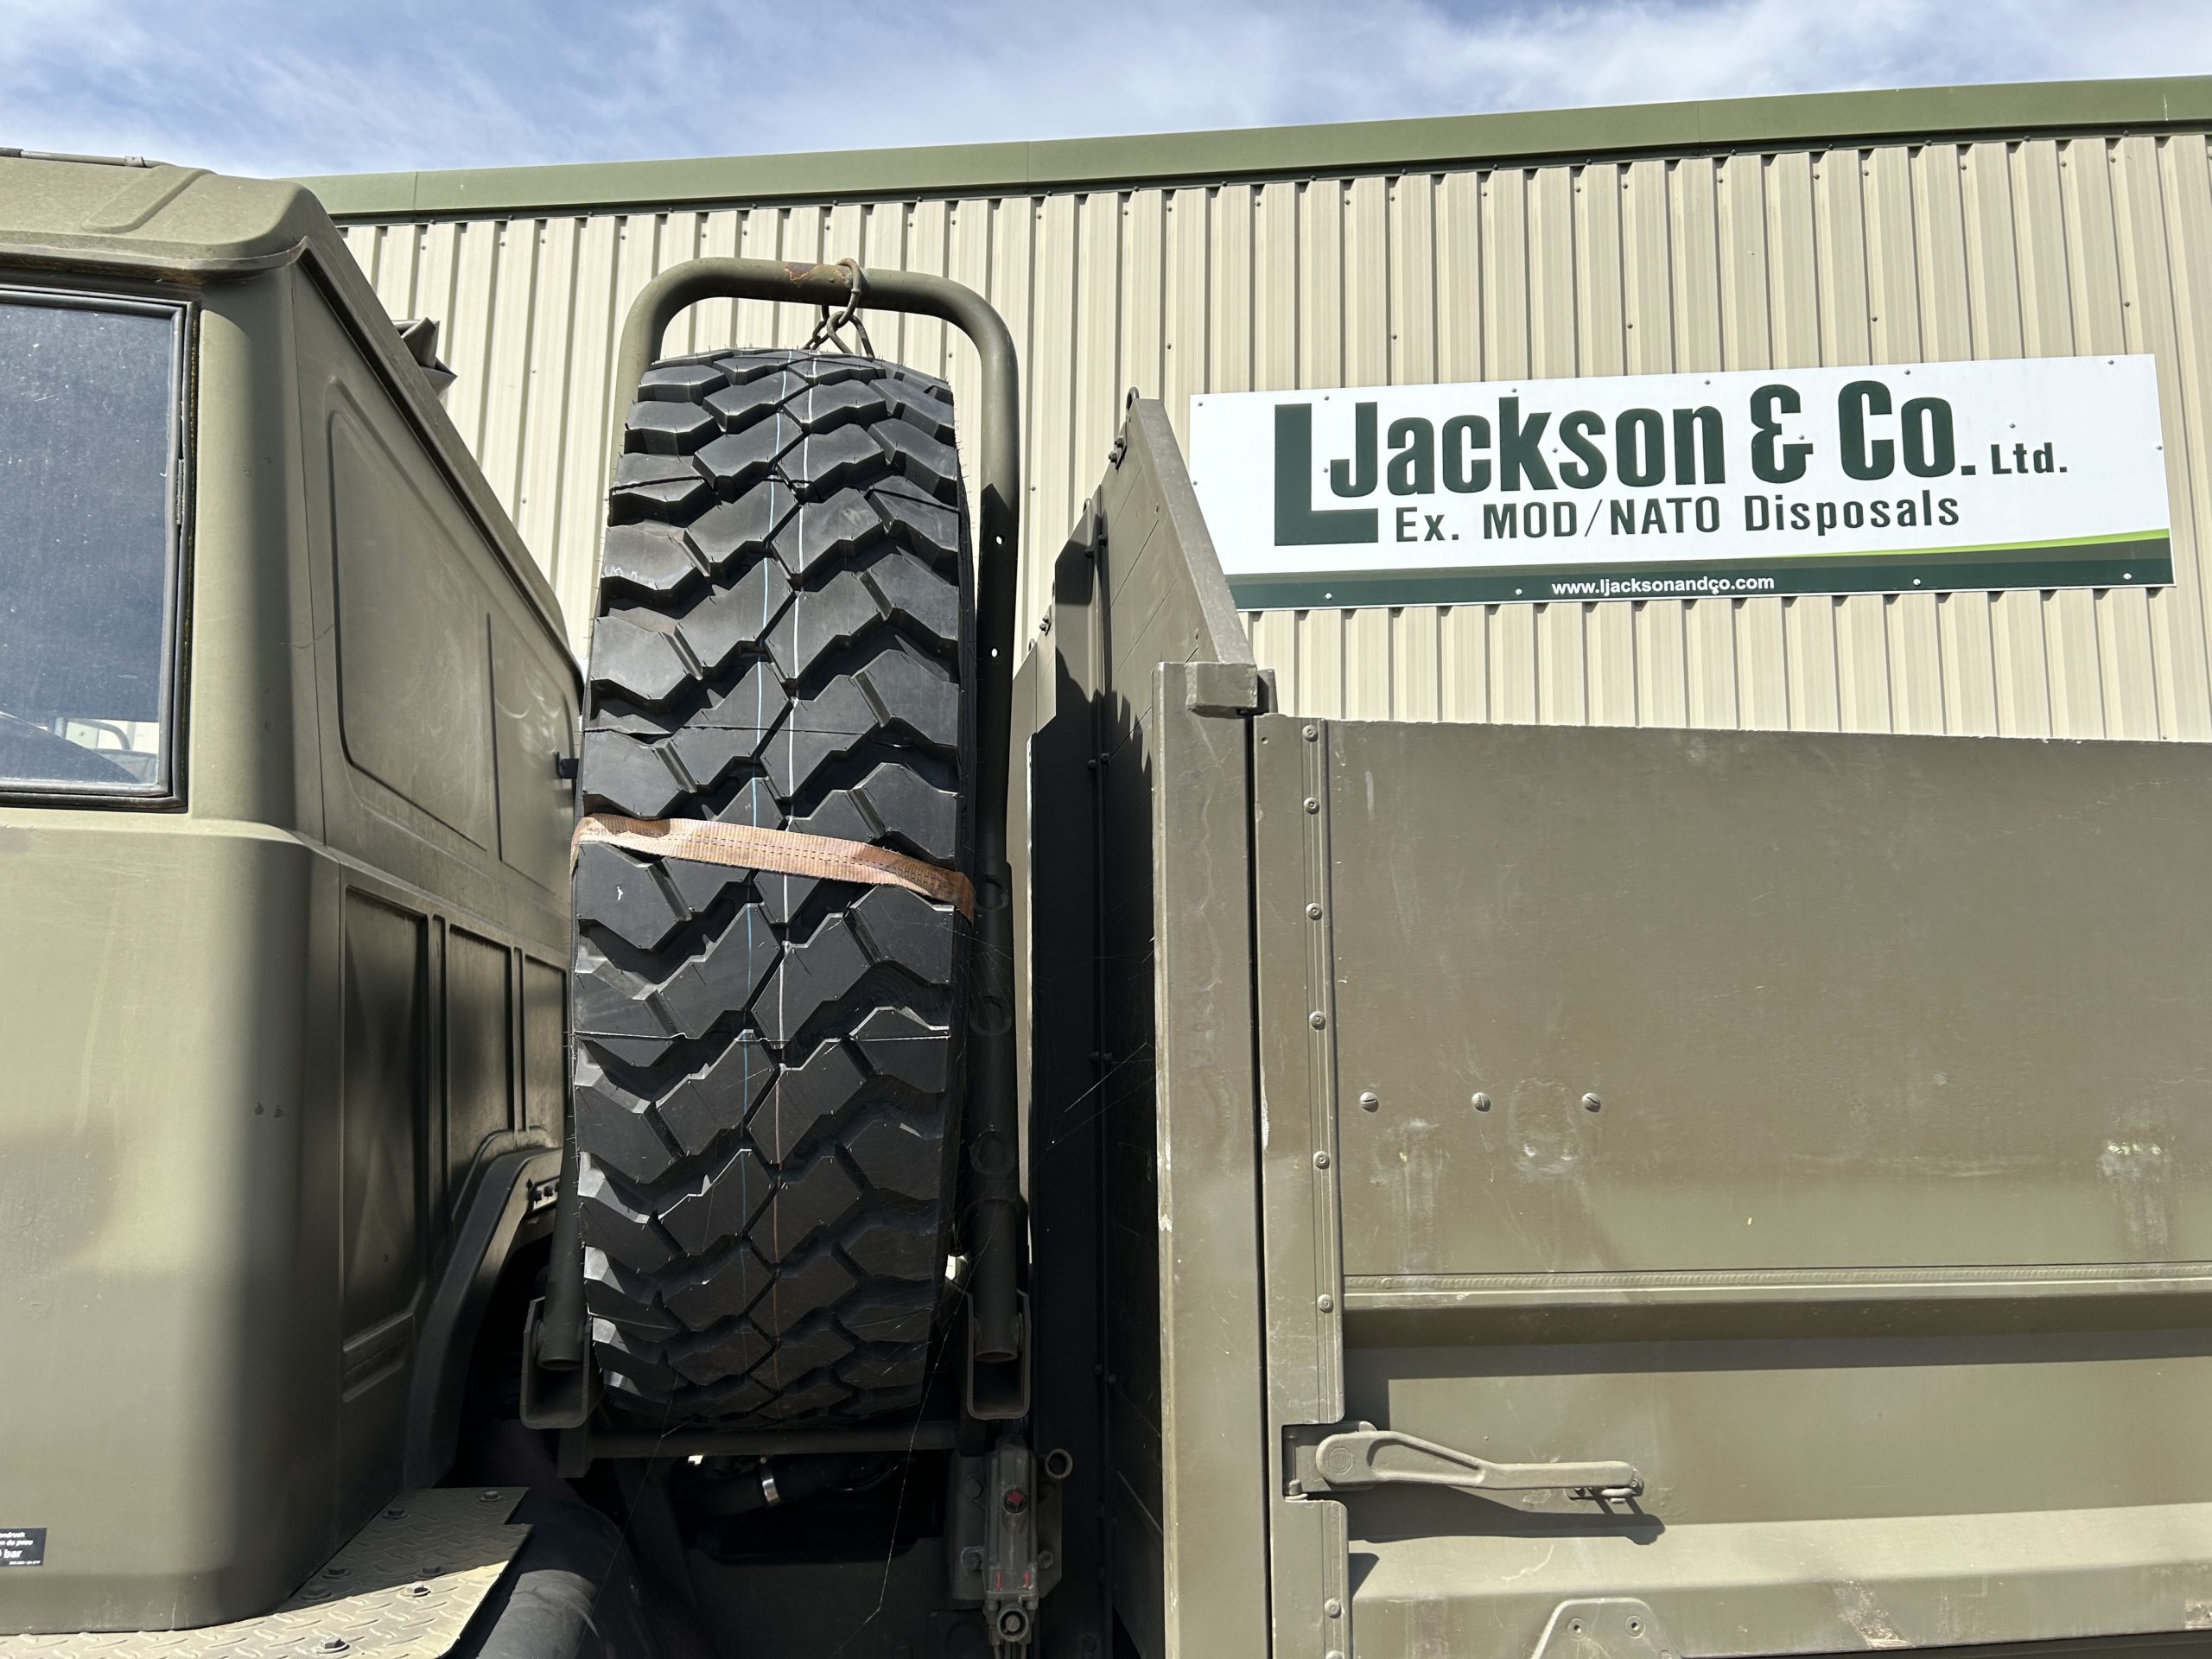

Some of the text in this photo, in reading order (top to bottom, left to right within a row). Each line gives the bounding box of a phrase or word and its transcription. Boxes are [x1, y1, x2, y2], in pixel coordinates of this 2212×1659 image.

[1750, 384, 1814, 484] &
[1838, 379, 1977, 480] Co.
[1990, 442, 2068, 474] Ltd.
[1395, 489, 1960, 542] Ex. MOD/NATO Disposals
[1551, 576, 1775, 596] www.ljacksonandco.com
